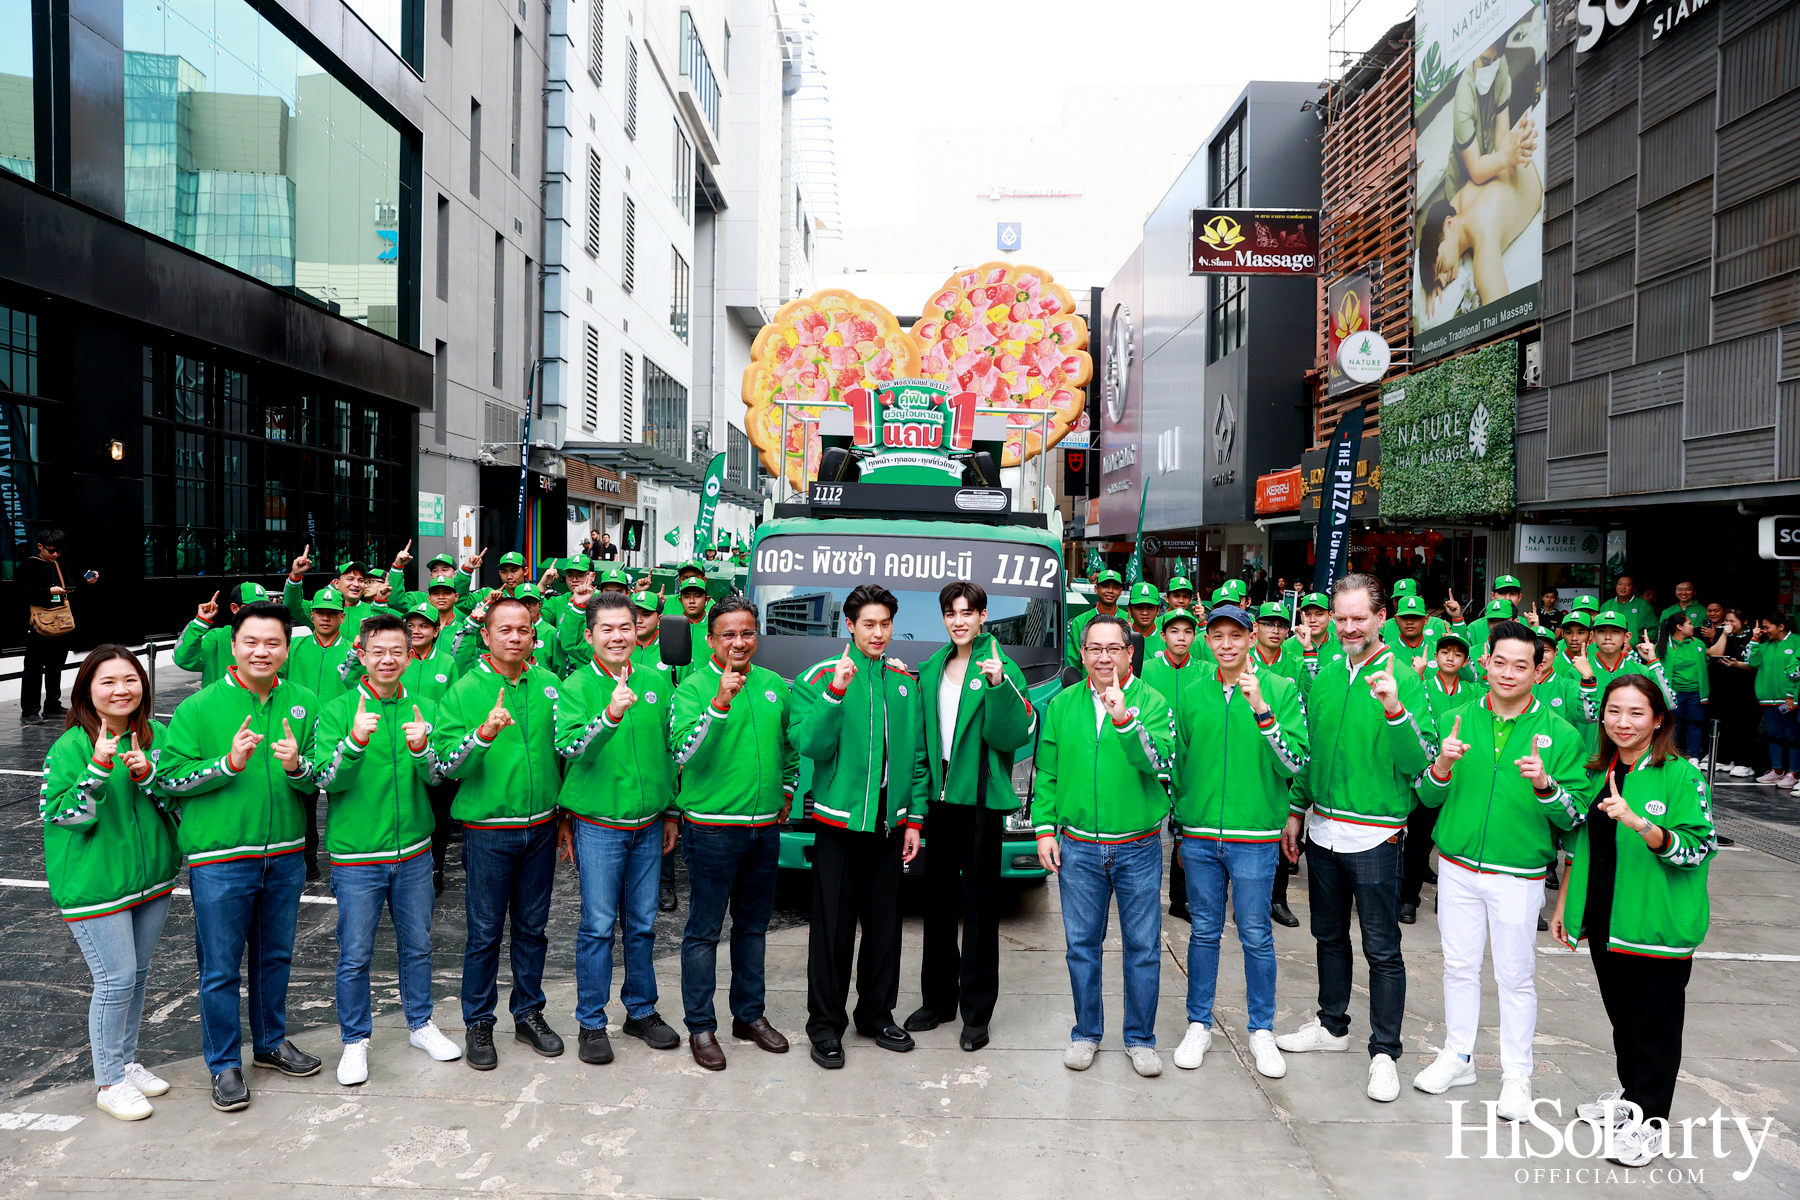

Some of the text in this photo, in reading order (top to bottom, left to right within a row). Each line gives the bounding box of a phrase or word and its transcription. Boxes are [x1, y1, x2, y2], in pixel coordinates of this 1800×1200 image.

[1235, 250, 1314, 271] Massage
[1421, 301, 1534, 354] Authentic Traditional Thai Massage
[883, 424, 943, 448] แถม
[1398, 411, 1462, 448] NATURE
[1338, 440, 1352, 466] THE
[1395, 444, 1465, 469] THA MASSAGE
[813, 487, 844, 501] 1112
[1266, 483, 1290, 497] KERRY
[1331, 471, 1352, 526] PIZZA
[1528, 535, 1576, 545] NATURE
[756, 545, 1059, 588] เดอะ พิซซ่า คอมปะนี 1112
[1647, 803, 1664, 811] PIZZA
